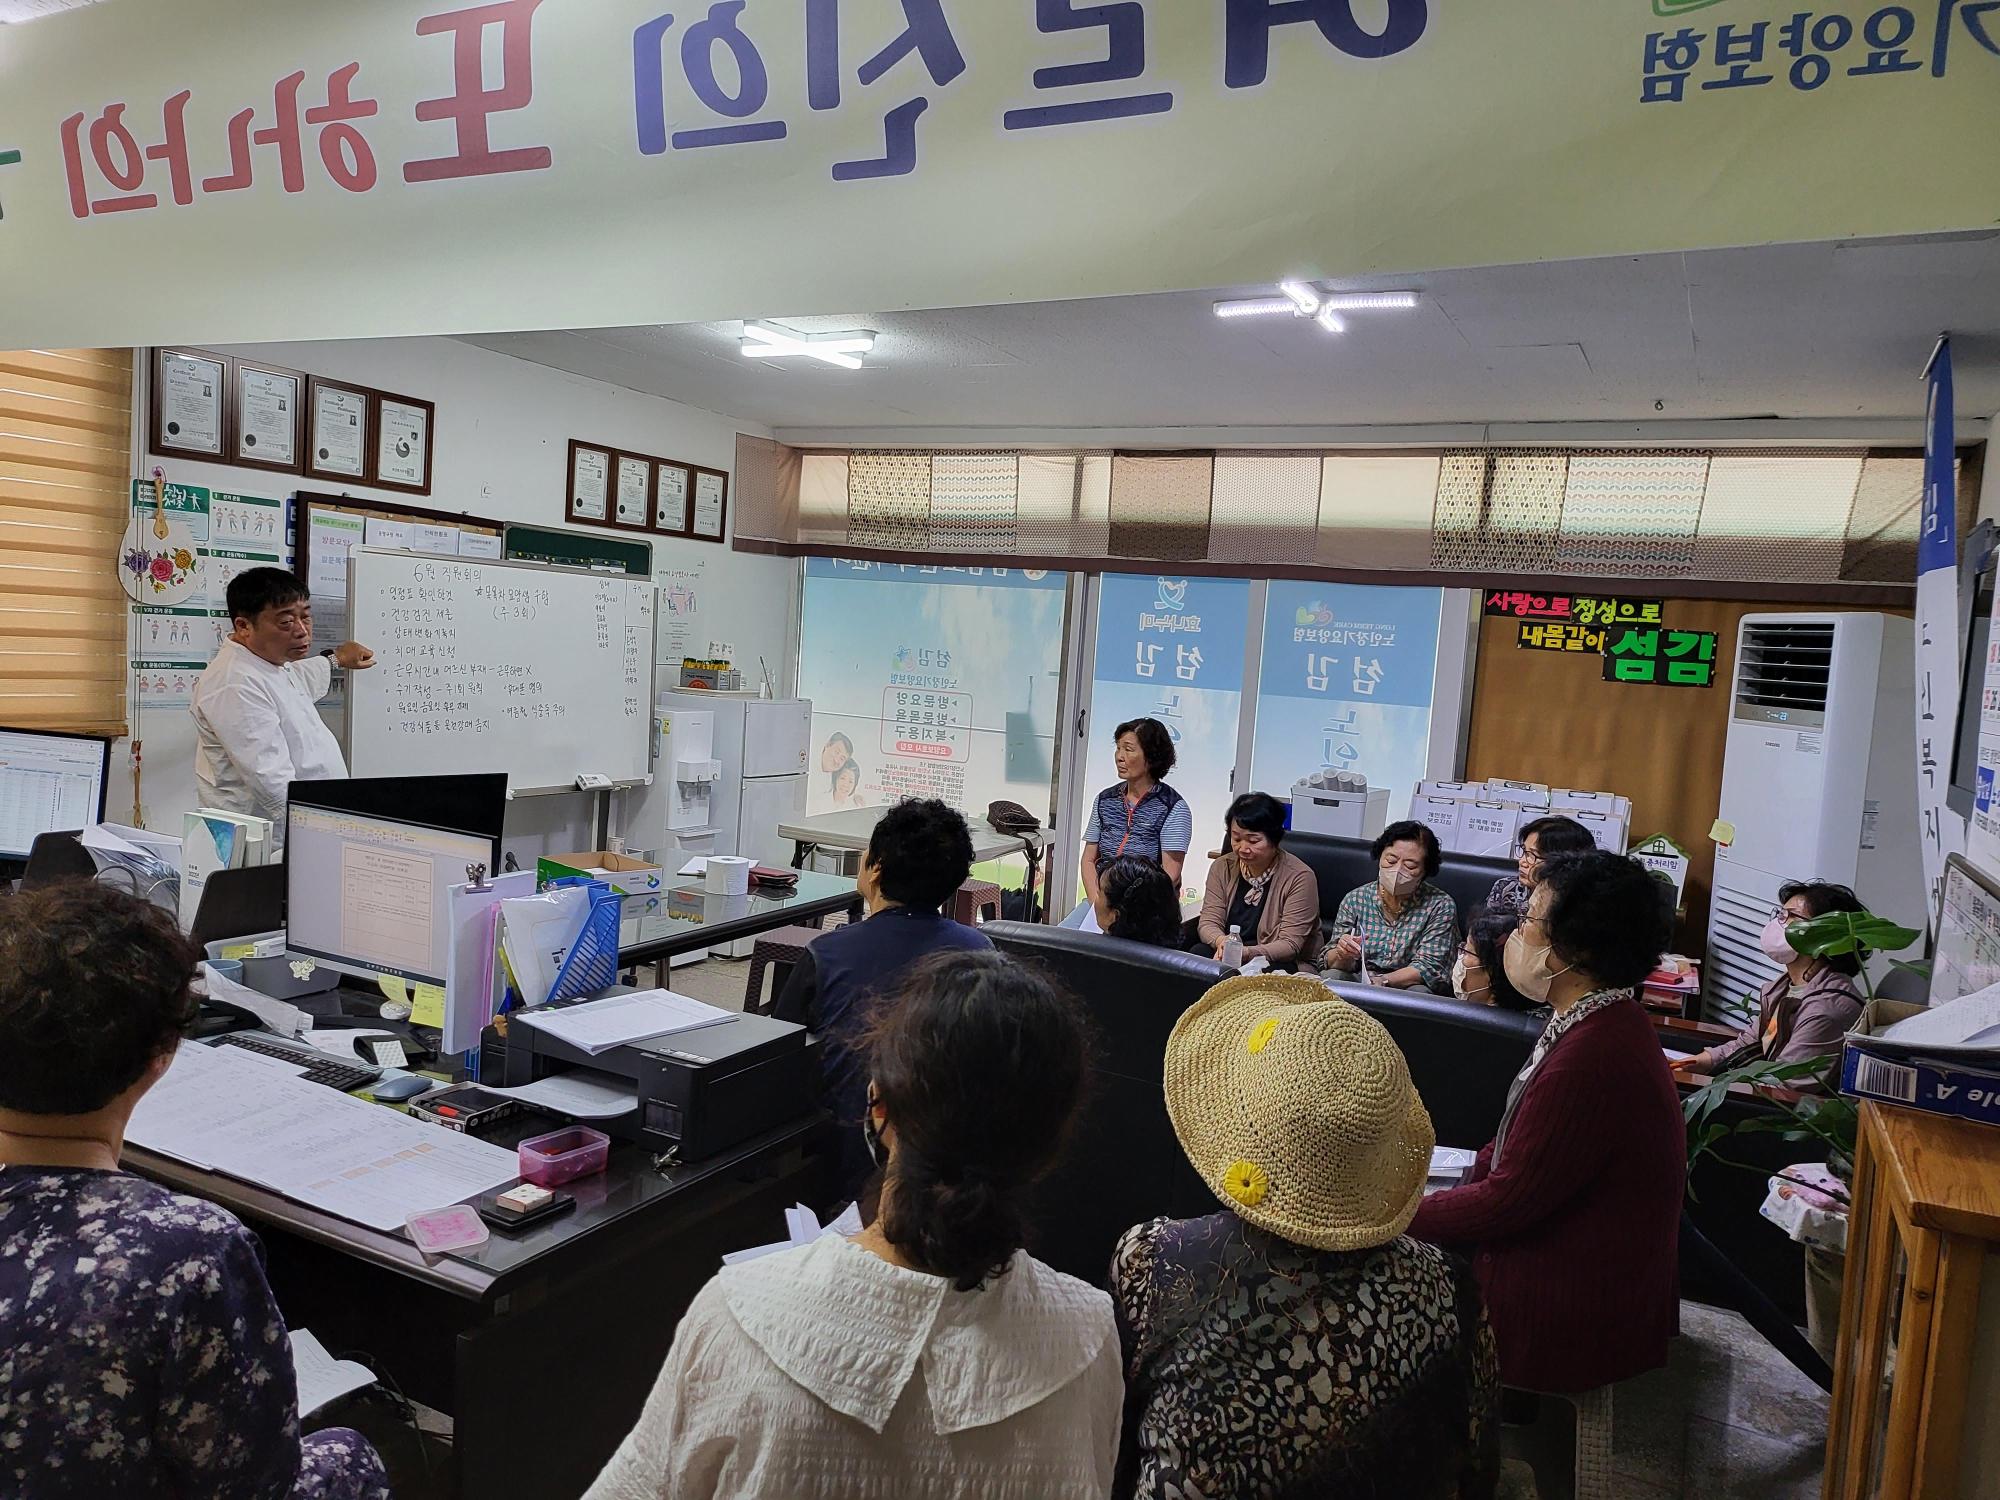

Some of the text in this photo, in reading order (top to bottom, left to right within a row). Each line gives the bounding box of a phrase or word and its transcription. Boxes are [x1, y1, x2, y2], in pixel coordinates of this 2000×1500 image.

[414, 564, 482, 582] 6월 직원회의
[1487, 592, 1662, 624] 사랑으로 정성으로
[1521, 624, 1605, 651] 내몸같이
[1610, 630, 1714, 685] 섬김
